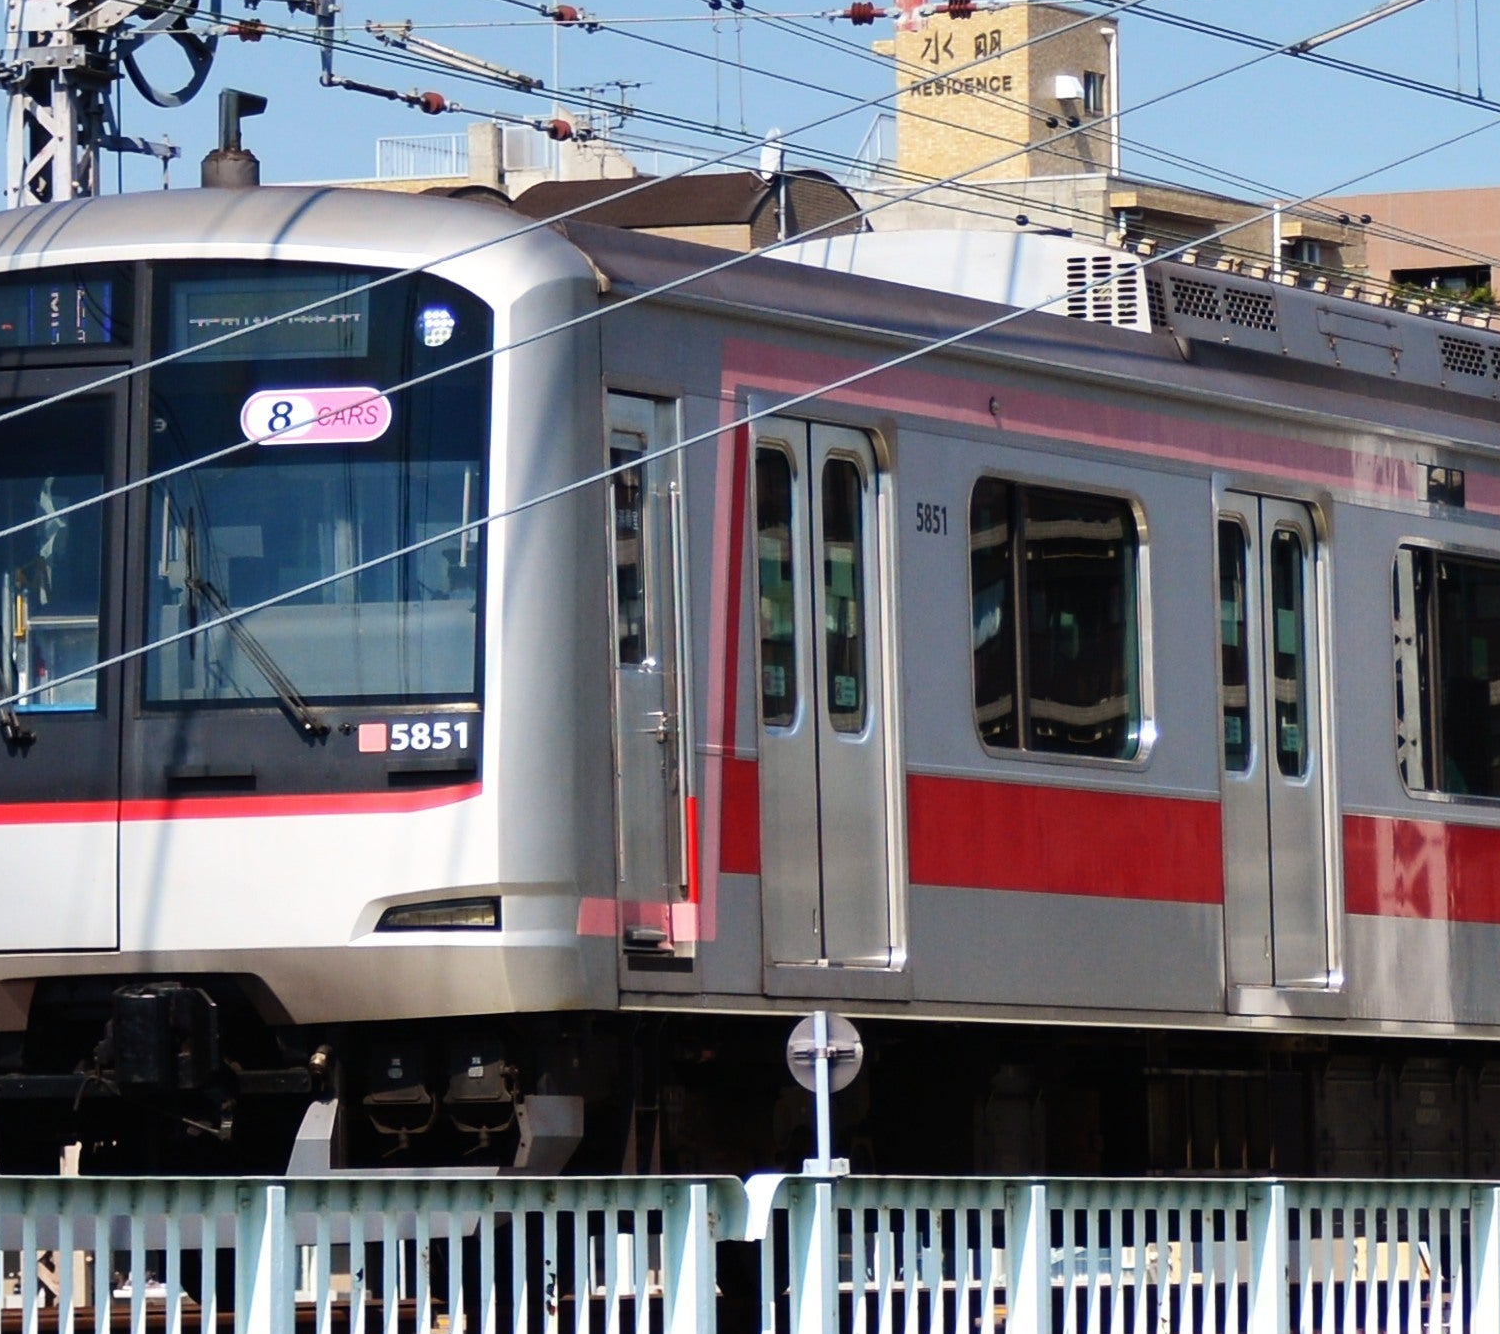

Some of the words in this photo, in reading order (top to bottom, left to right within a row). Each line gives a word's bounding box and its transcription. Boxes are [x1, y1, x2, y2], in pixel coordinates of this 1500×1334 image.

[911, 75, 1012, 97] RESIDENCE
[268, 401, 293, 433] 8
[317, 405, 379, 427] CARS
[916, 502, 947, 536] 5851
[390, 722, 468, 751] 5851
